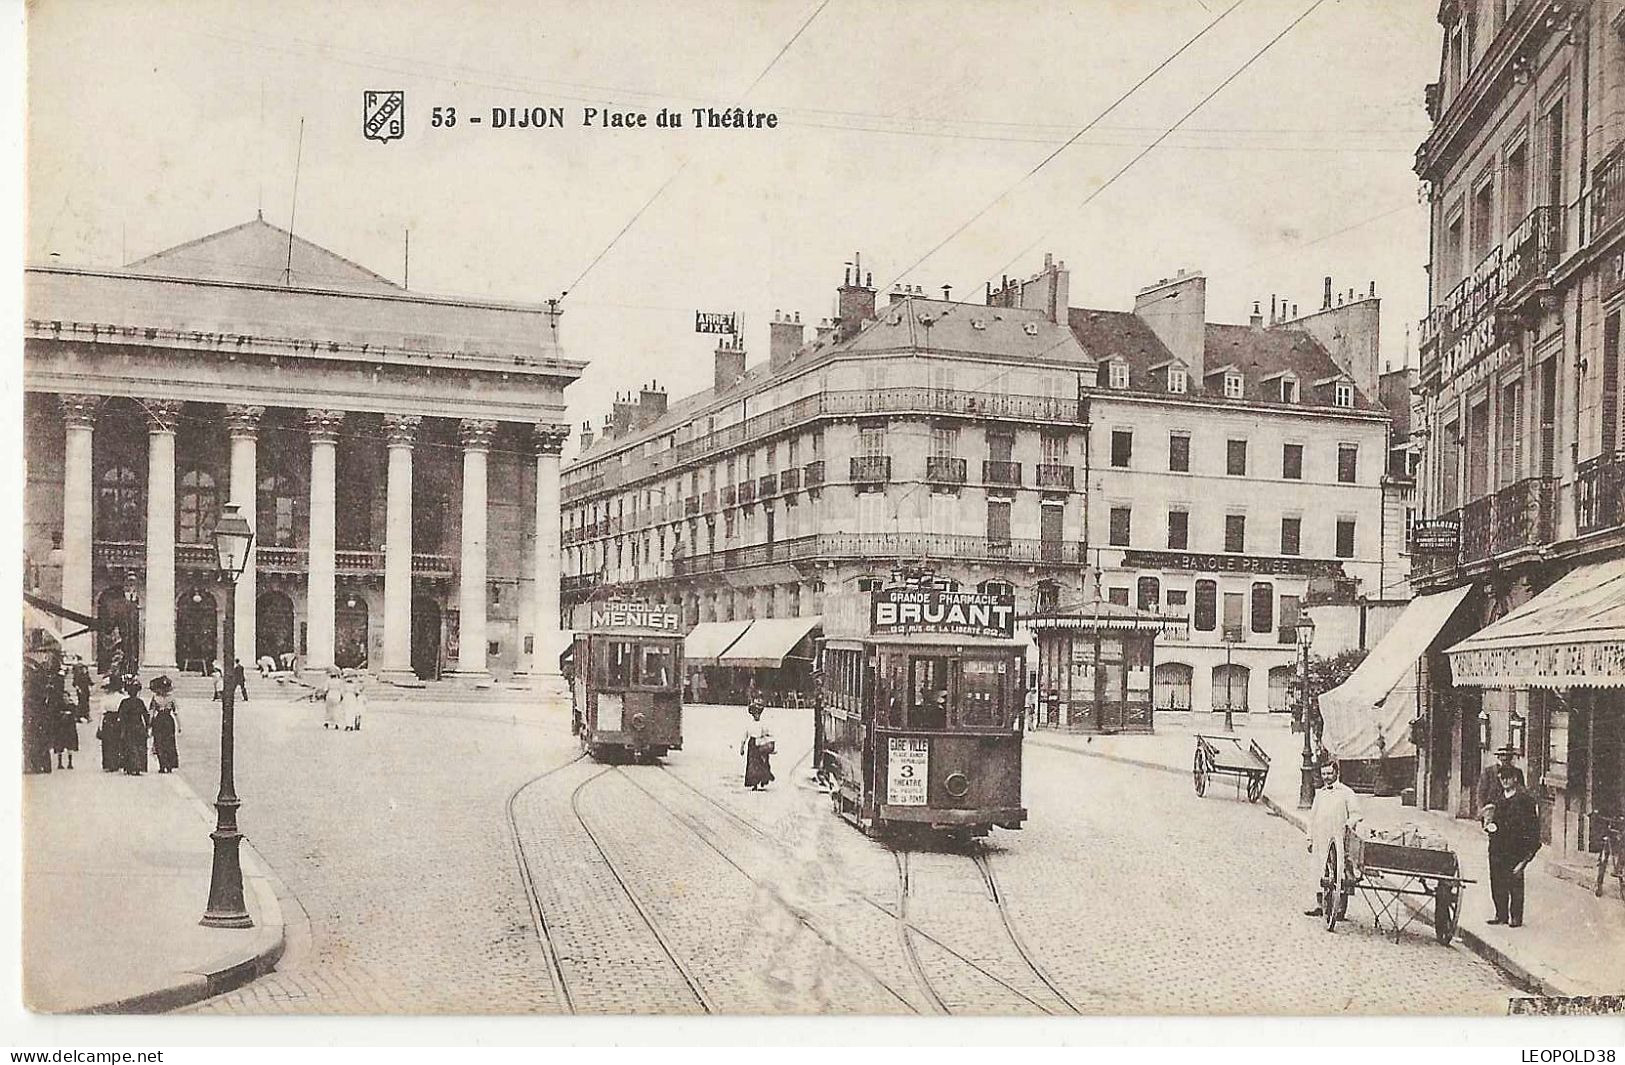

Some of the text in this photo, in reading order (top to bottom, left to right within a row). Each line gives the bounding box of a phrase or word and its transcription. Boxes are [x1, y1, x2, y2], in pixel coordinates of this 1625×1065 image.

[701, 323, 731, 333] FIXE
[890, 593, 999, 605] GRANDE PHARMACIE
[603, 602, 668, 612] CHOCOLAT
[592, 611, 678, 629] MENIER
[876, 602, 1013, 628] BRUANT
[901, 765, 914, 778] 3
